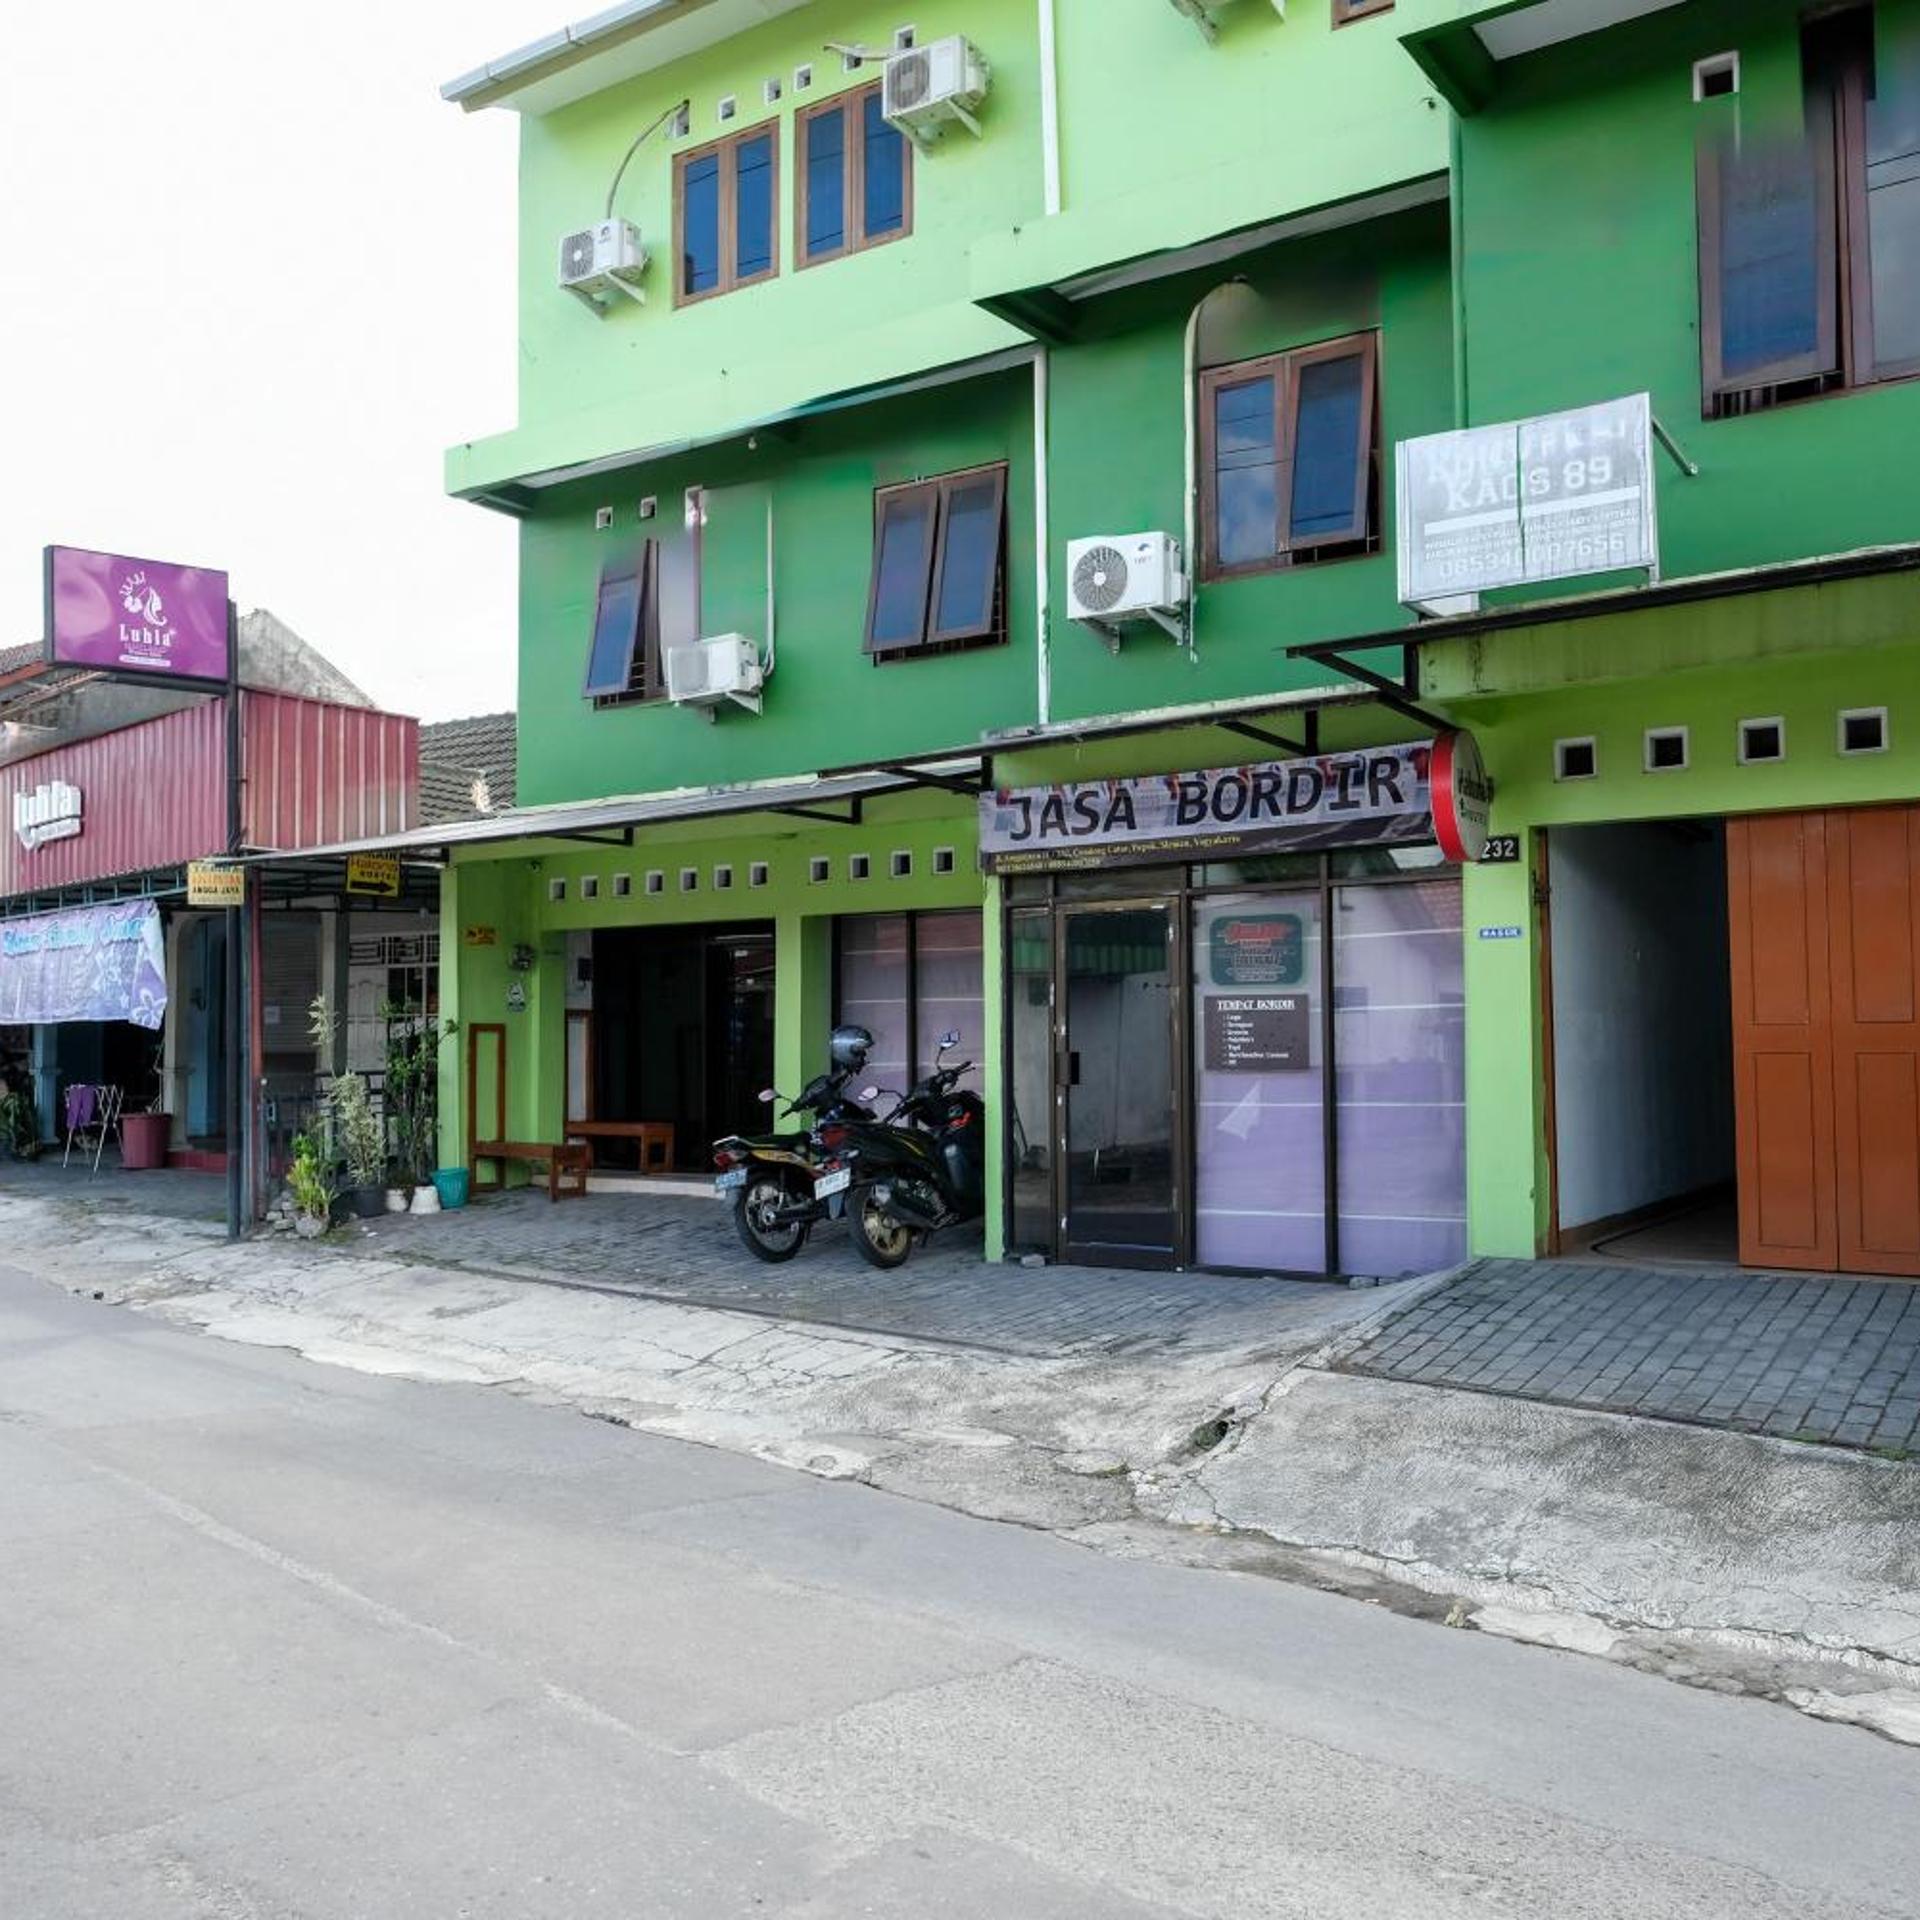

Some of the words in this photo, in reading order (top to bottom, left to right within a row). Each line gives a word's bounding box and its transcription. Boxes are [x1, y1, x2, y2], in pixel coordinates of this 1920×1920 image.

[1564, 455, 1613, 490] 89
[1009, 791, 1137, 841] JASA
[1176, 757, 1405, 826] BORDIR
[1483, 839, 1515, 858] 232
